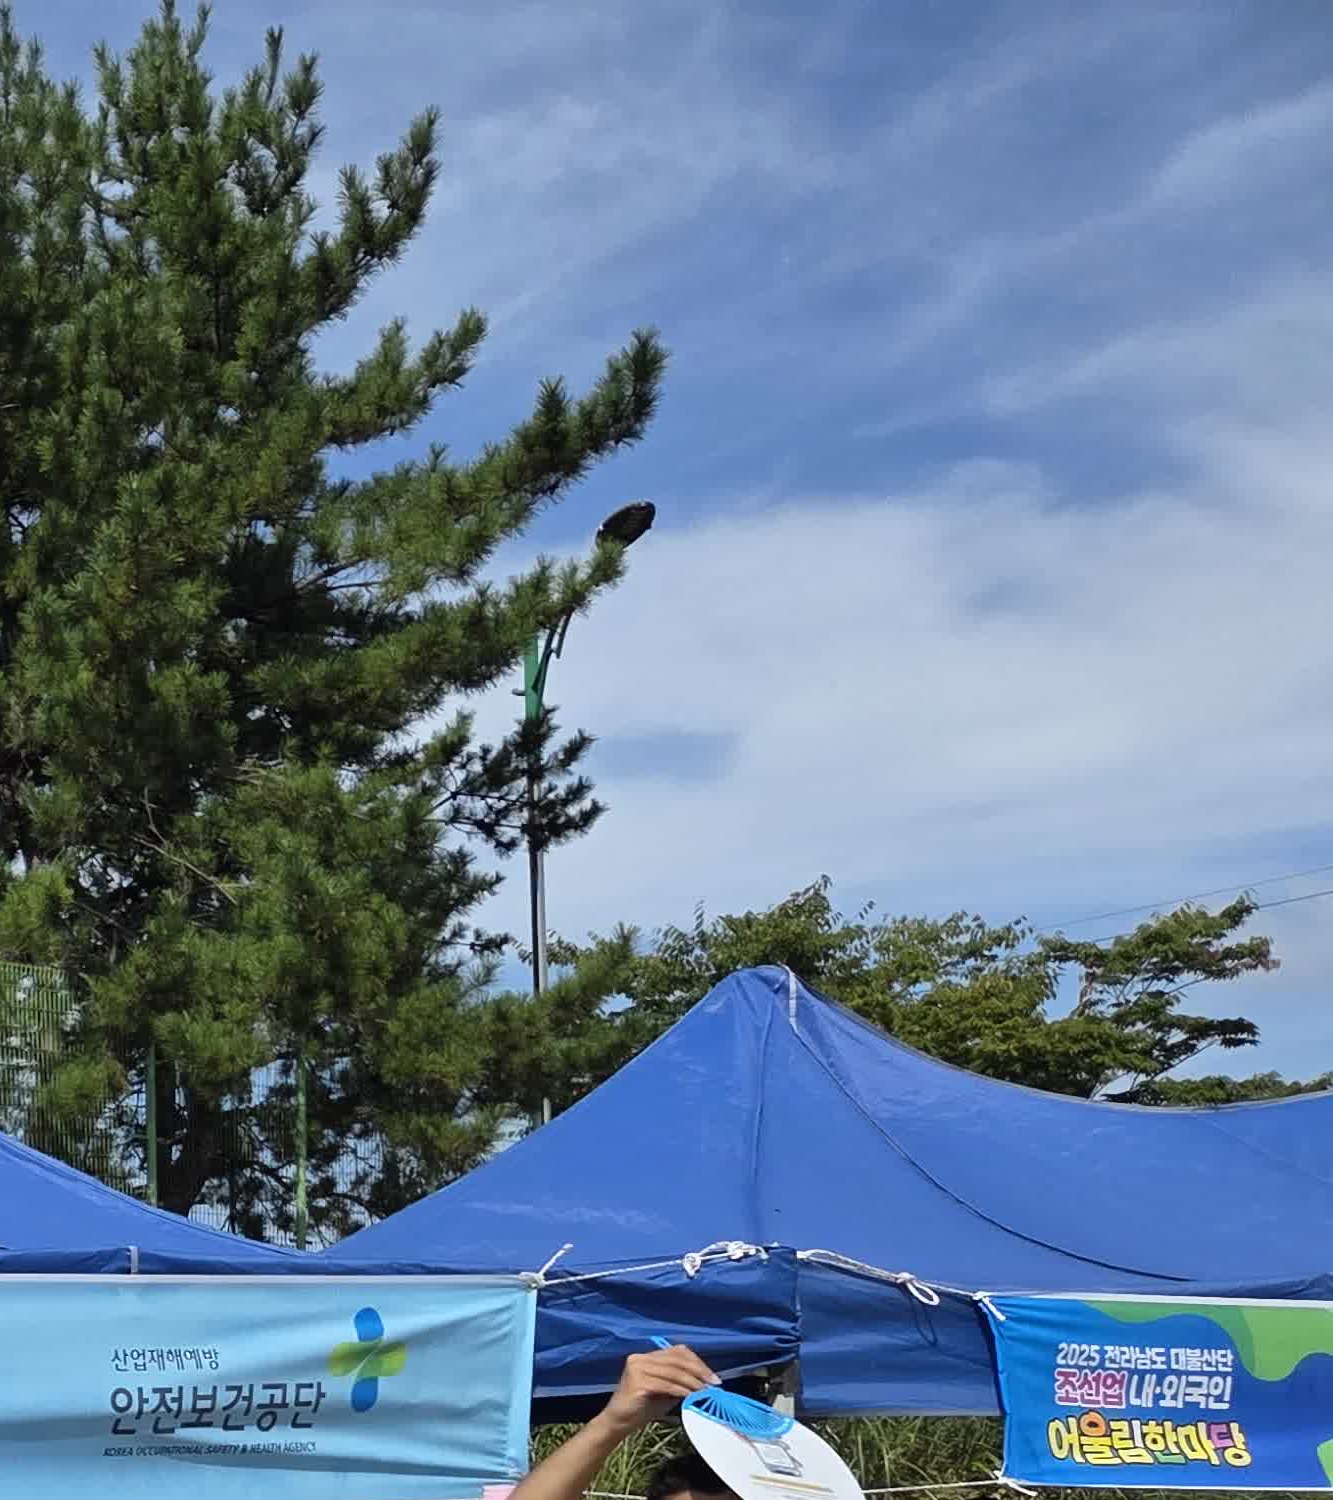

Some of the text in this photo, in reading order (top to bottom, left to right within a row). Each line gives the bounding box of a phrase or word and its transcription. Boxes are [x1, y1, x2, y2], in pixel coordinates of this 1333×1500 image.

[111, 1347, 219, 1372] 산업재해예방
[1056, 1343, 1233, 1372] 2025 전라남도 대불산단
[1055, 1368, 1232, 1410] 조선업 내·외국인
[110, 1381, 326, 1435] 안전보건공단
[250, 1442, 282, 1455] HEALTH
[283, 1441, 317, 1454] AGENCY
[1046, 1409, 1253, 1467] 어울림한마당
